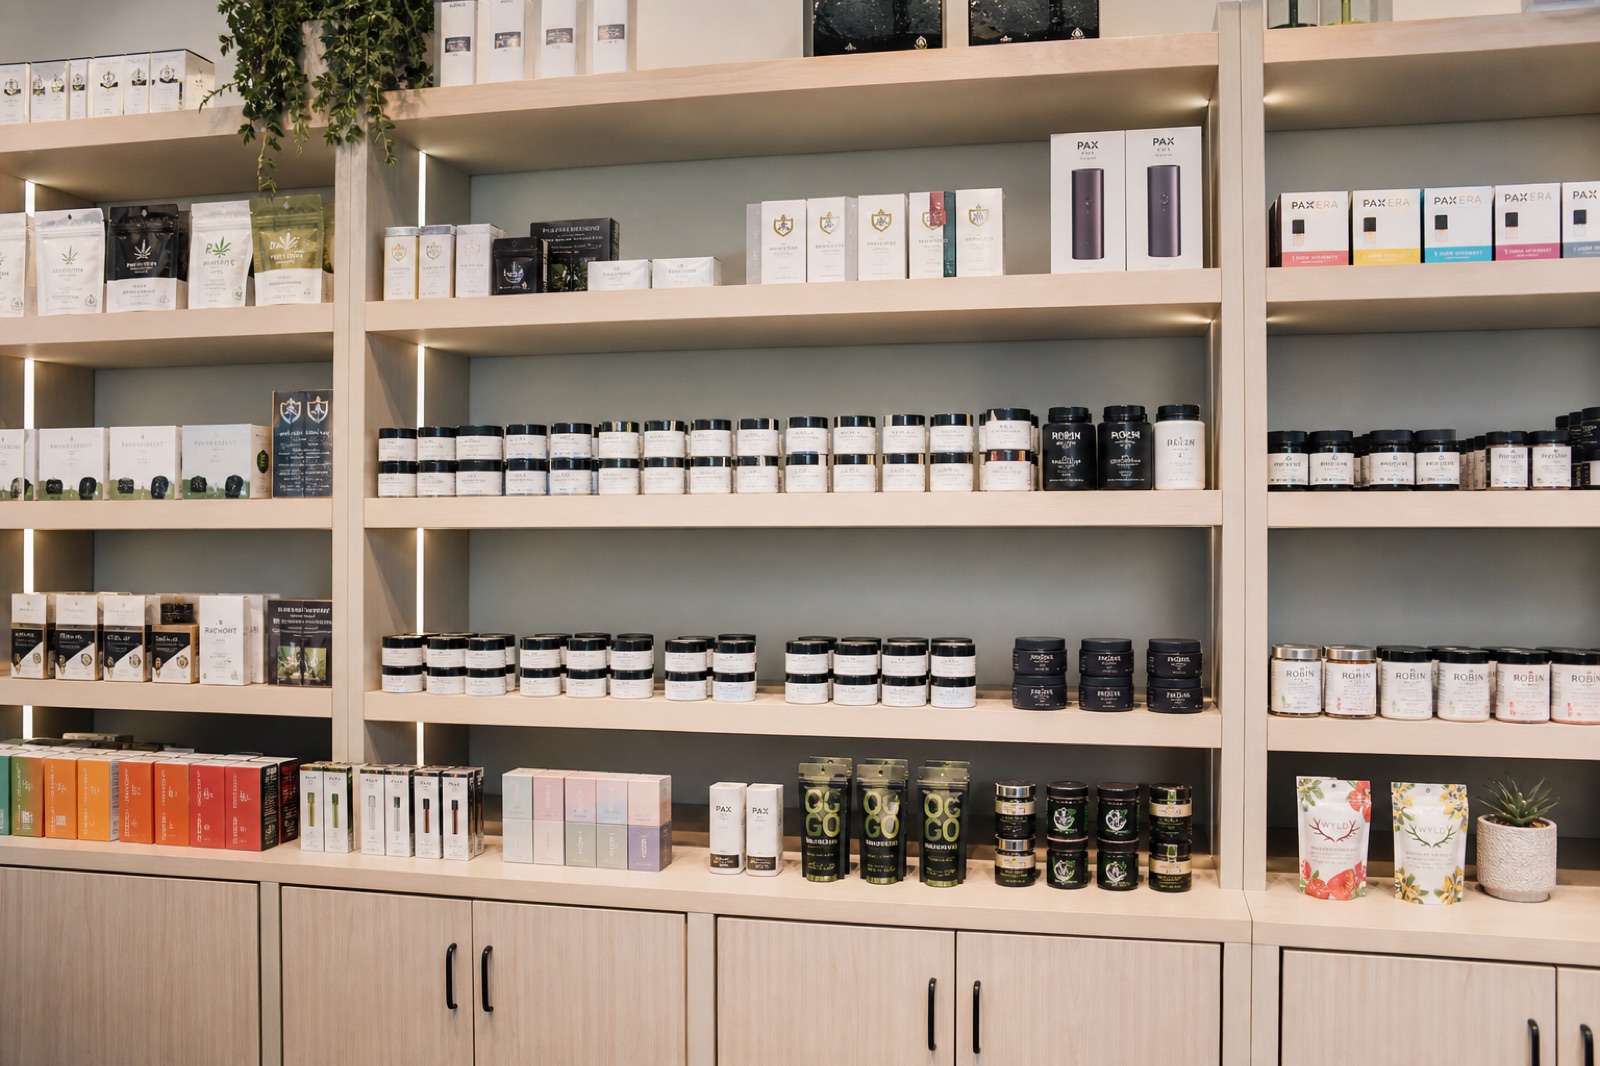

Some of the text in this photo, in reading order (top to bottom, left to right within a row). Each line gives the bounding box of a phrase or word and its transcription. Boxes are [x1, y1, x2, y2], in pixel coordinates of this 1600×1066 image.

[1077, 141, 1099, 150] PAX
[1153, 137, 1175, 146] PAX
[1573, 190, 1597, 200] PAX
[1286, 671, 1315, 679] ROBIN
[1395, 672, 1426, 681] ROBIN
[1454, 673, 1483, 682] ROBIN
[1514, 674, 1544, 682] ROBIN
[716, 805, 732, 813] PAX
[752, 807, 769, 815] PAX
[1321, 821, 1349, 830] WYLD
[1419, 826, 1446, 835] WYLD
